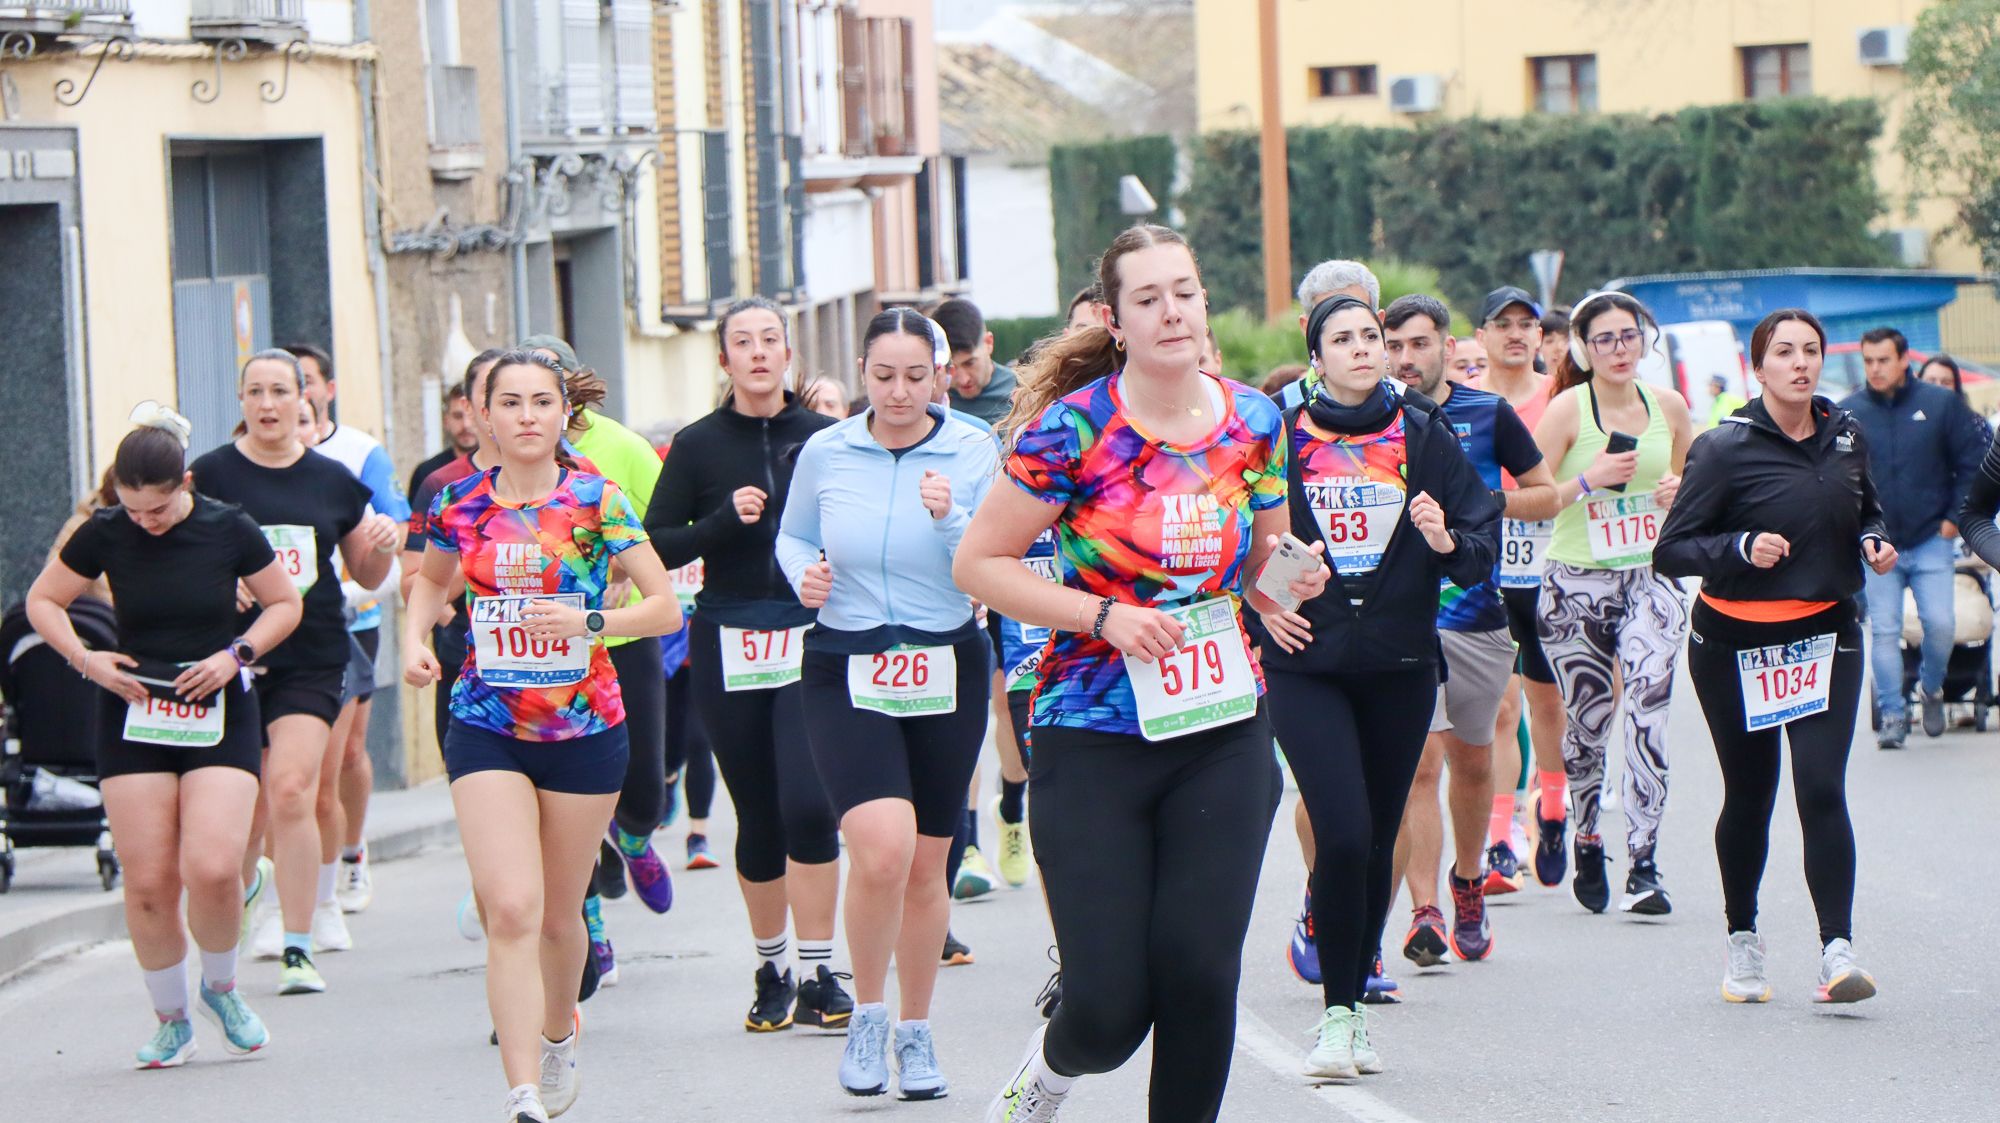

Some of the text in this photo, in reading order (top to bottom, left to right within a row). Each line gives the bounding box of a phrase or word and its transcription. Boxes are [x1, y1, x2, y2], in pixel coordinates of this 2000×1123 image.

[1161, 494, 1200, 523] XII
[1162, 523, 1203, 539] MEDIA
[1330, 511, 1369, 543] 53
[1601, 515, 1657, 547] 1176
[495, 543, 525, 565] XII
[1161, 534, 1222, 555] MARATÓN
[1501, 541, 1534, 565] 93
[495, 565, 526, 577] MEDIA
[1169, 554, 1194, 568] 10K
[496, 575, 544, 588] MARATÓN
[488, 599, 521, 622] 21K
[742, 628, 791, 661] 577
[872, 652, 929, 688] 226
[1015, 656, 1040, 677] Club
[1157, 639, 1225, 696] 579
[1756, 661, 1818, 702] 1034
